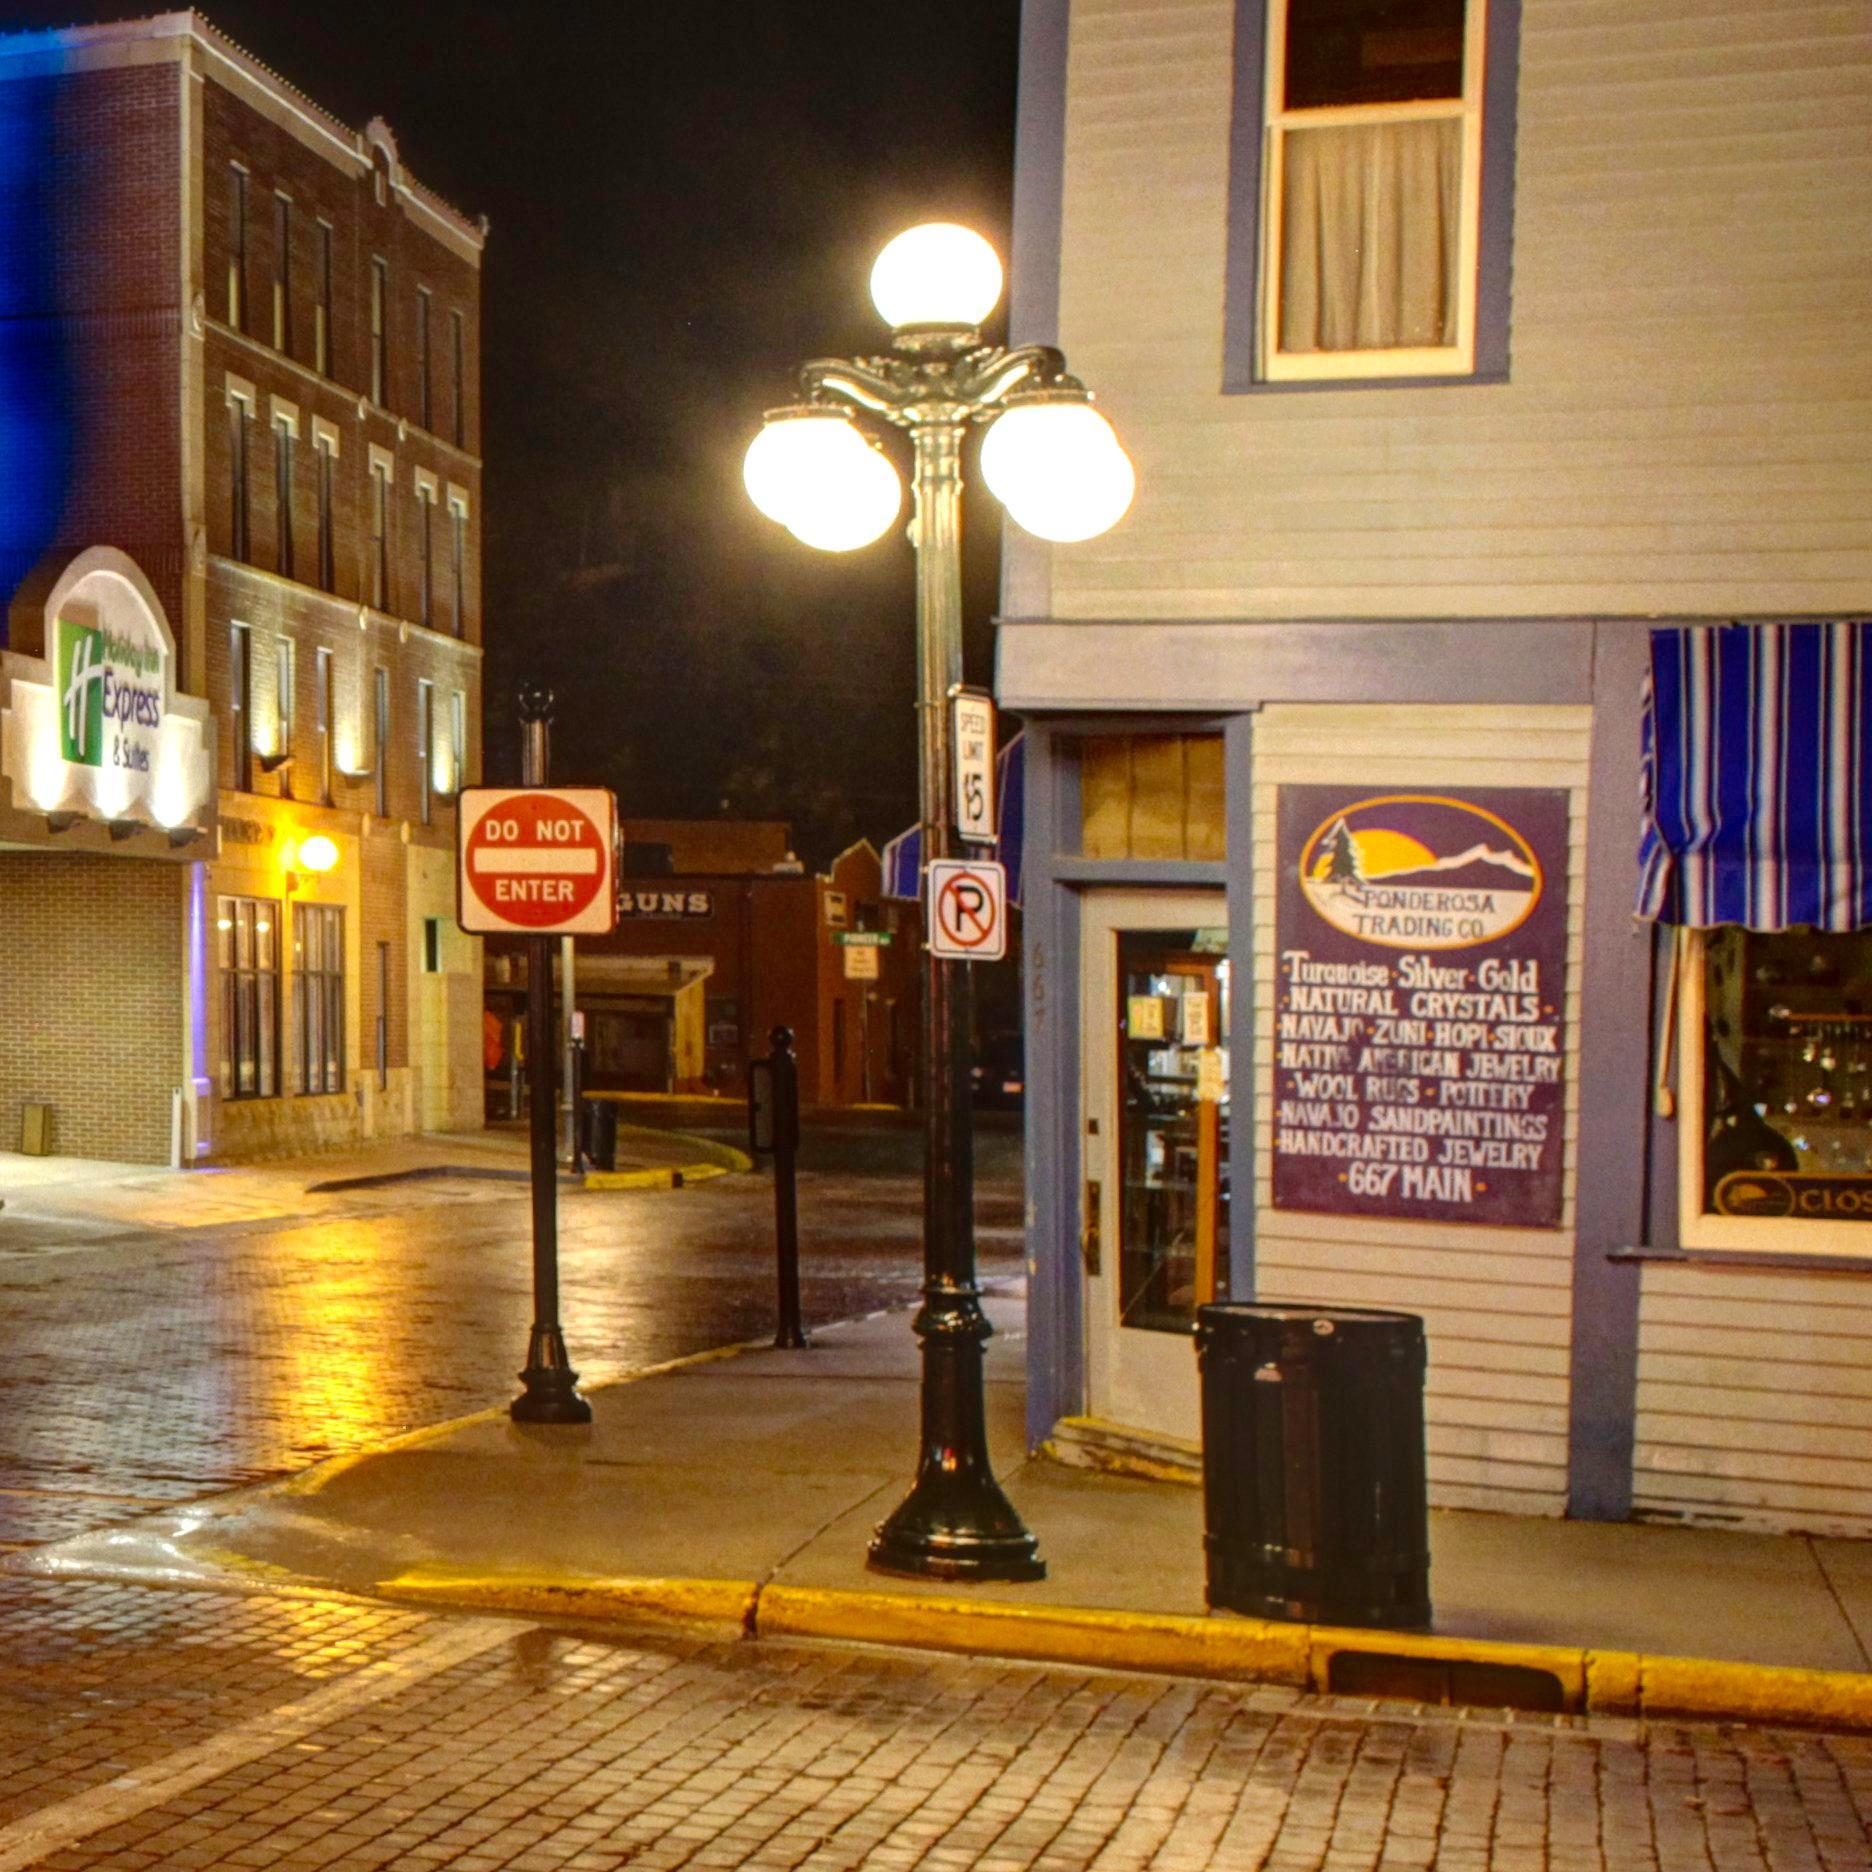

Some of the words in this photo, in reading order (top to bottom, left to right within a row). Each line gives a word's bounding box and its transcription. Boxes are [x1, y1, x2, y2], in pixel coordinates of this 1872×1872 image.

[103, 664, 160, 733] Express
[960, 712, 986, 735] SPEED
[123, 737, 150, 772] Suites
[485, 819, 520, 841] DO
[536, 820, 585, 842] NOT
[495, 879, 575, 903] ENTER
[1362, 891, 1496, 914] PONDEROSA
[1353, 914, 1453, 937] TRADING
[1457, 919, 1484, 938] CO
[1282, 951, 1390, 988] Turquoise
[1397, 954, 1469, 990] Silver
[1477, 958, 1538, 993] Gold
[1289, 986, 1399, 1016] NATURAL
[1410, 990, 1540, 1022] CRYSTALS
[1371, 1018, 1427, 1047] ZUNI
[1432, 1023, 1488, 1050] HOPI
[1494, 1025, 1557, 1050] SIOUX
[1465, 1052, 1563, 1082] JEWELRY
[1293, 1071, 1358, 1100] WOOL
[1366, 1076, 1420, 1104] RUGS
[1439, 1081, 1536, 1110] POTTERY
[1280, 1100, 1360, 1129] NAVAJO
[1368, 1105, 1549, 1141] SANDPAINTINGS
[1279, 1129, 1429, 1162] HANDCRAFTED
[1437, 1138, 1544, 1170] JEWELRY
[1347, 1162, 1399, 1196] 667
[1401, 1167, 1473, 1202] MAIN
